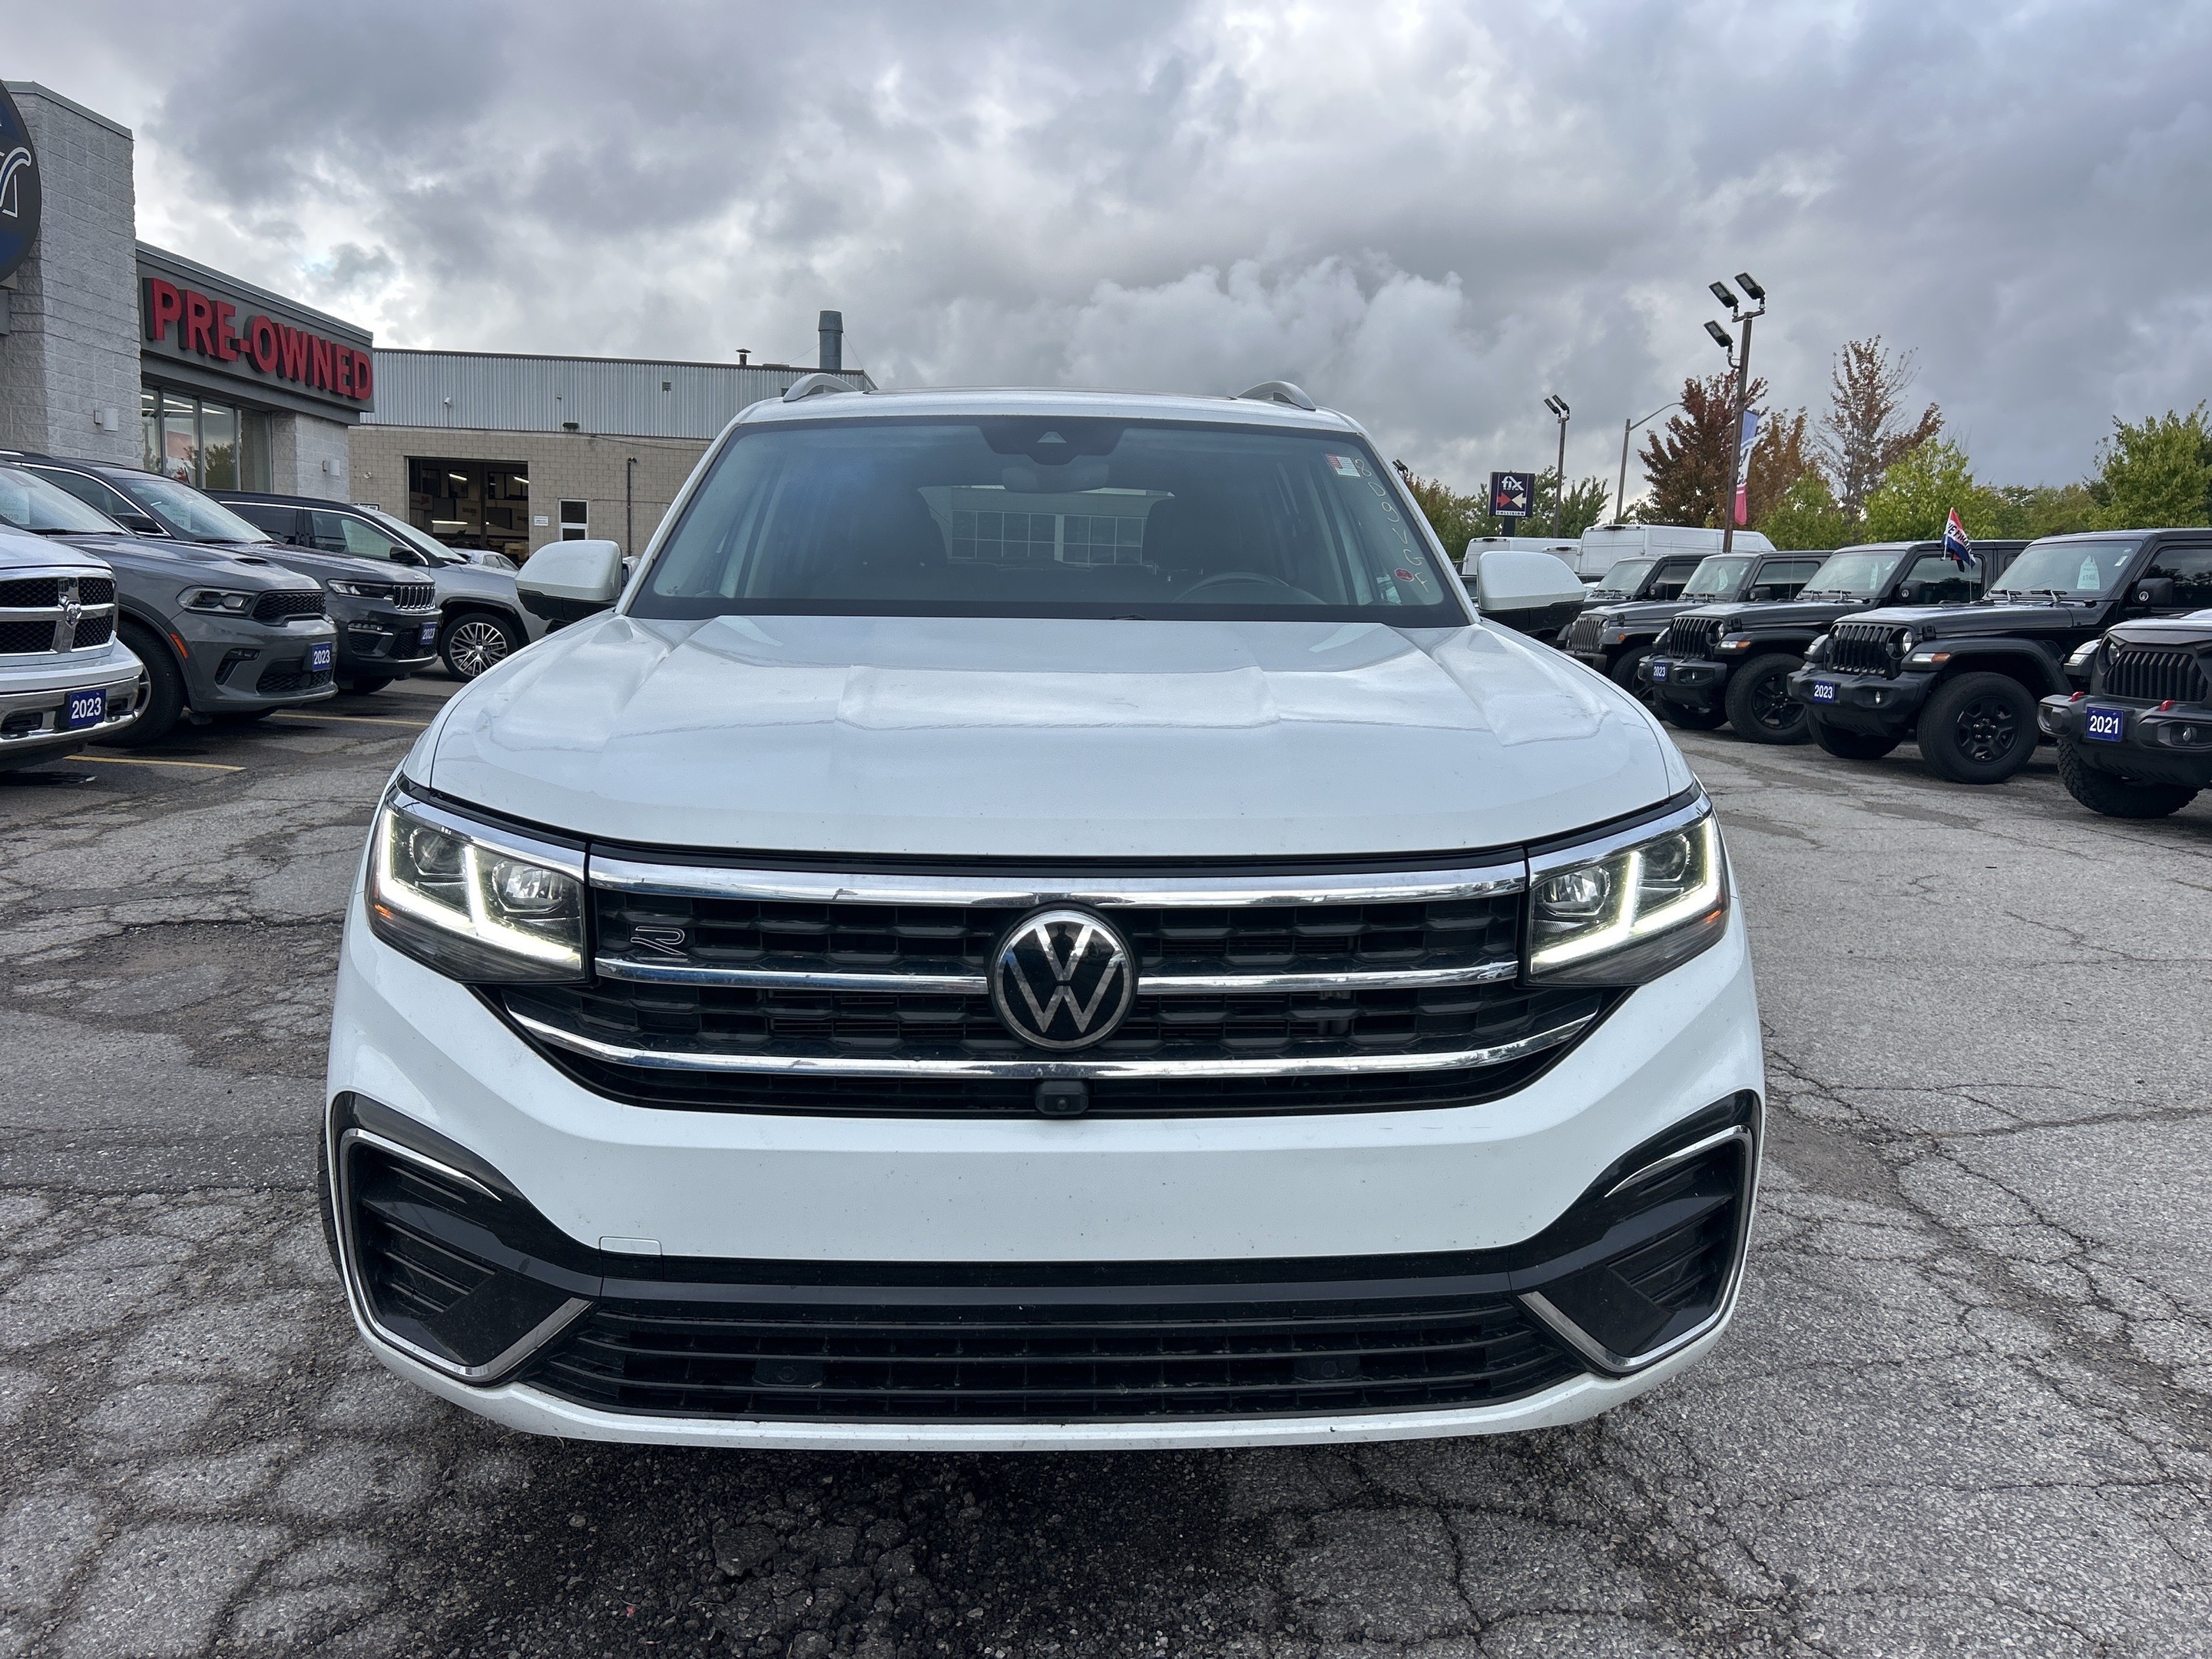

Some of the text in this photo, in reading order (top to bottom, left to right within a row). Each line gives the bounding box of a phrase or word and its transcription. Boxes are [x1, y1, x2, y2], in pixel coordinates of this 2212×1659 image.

[144, 278, 373, 400] PRE-OWNED
[1502, 476, 1524, 491] fix
[422, 628, 435, 640] 2023
[313, 649, 330, 665] 2023
[1653, 665, 1666, 677] 2023
[1813, 684, 1833, 700] 2023
[71, 697, 102, 720] 2023
[2089, 714, 2119, 734] 2021
